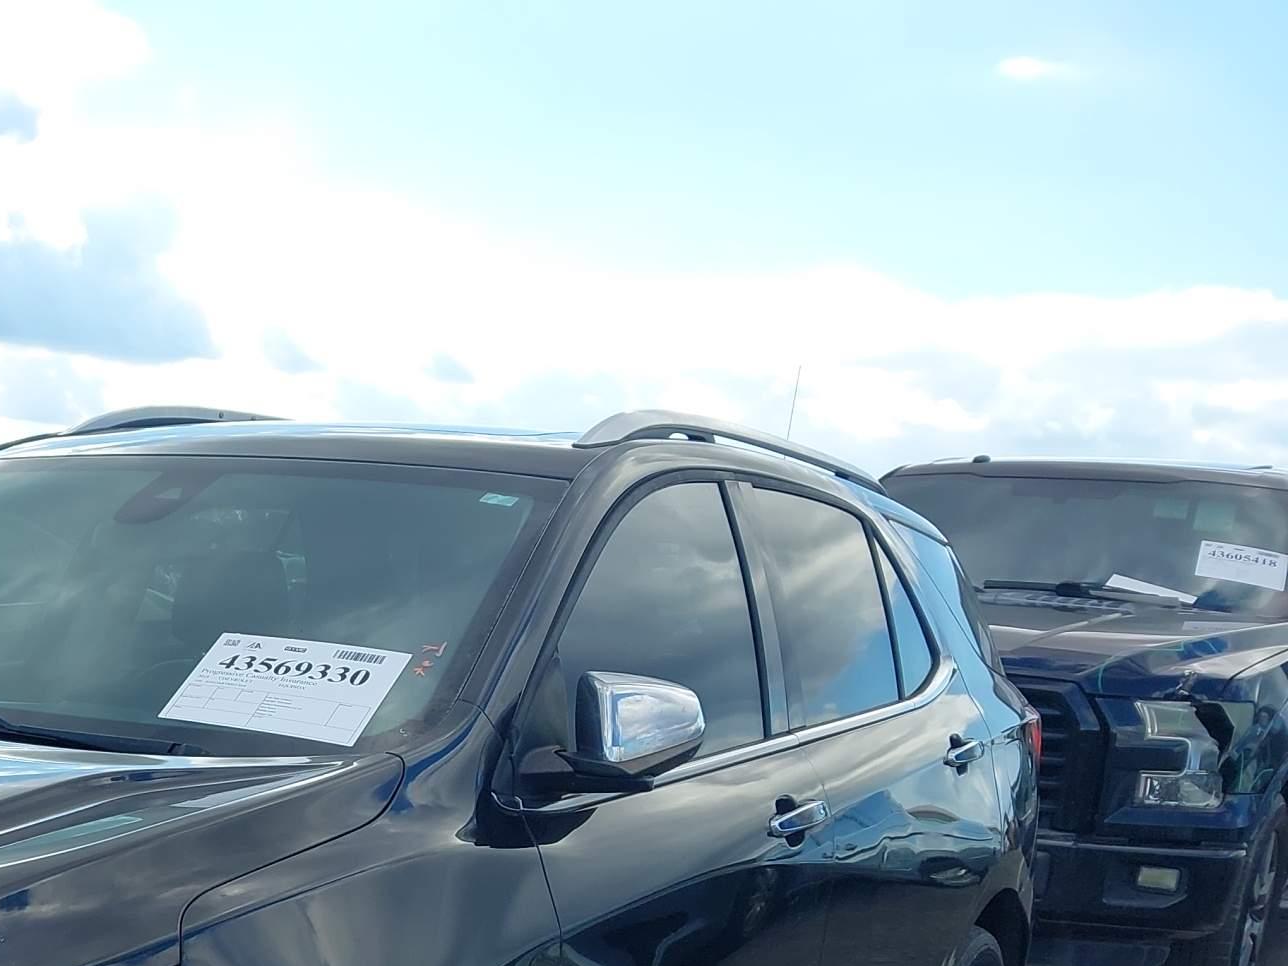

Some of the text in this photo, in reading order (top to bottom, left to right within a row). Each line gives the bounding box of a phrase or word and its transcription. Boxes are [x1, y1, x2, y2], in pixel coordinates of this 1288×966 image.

[1208, 550, 1278, 567] 43605418
[200, 667, 244, 678] Progressive
[245, 672, 279, 682] Casualty
[280, 676, 318, 687] Insurance
[219, 654, 371, 686] 43569330
